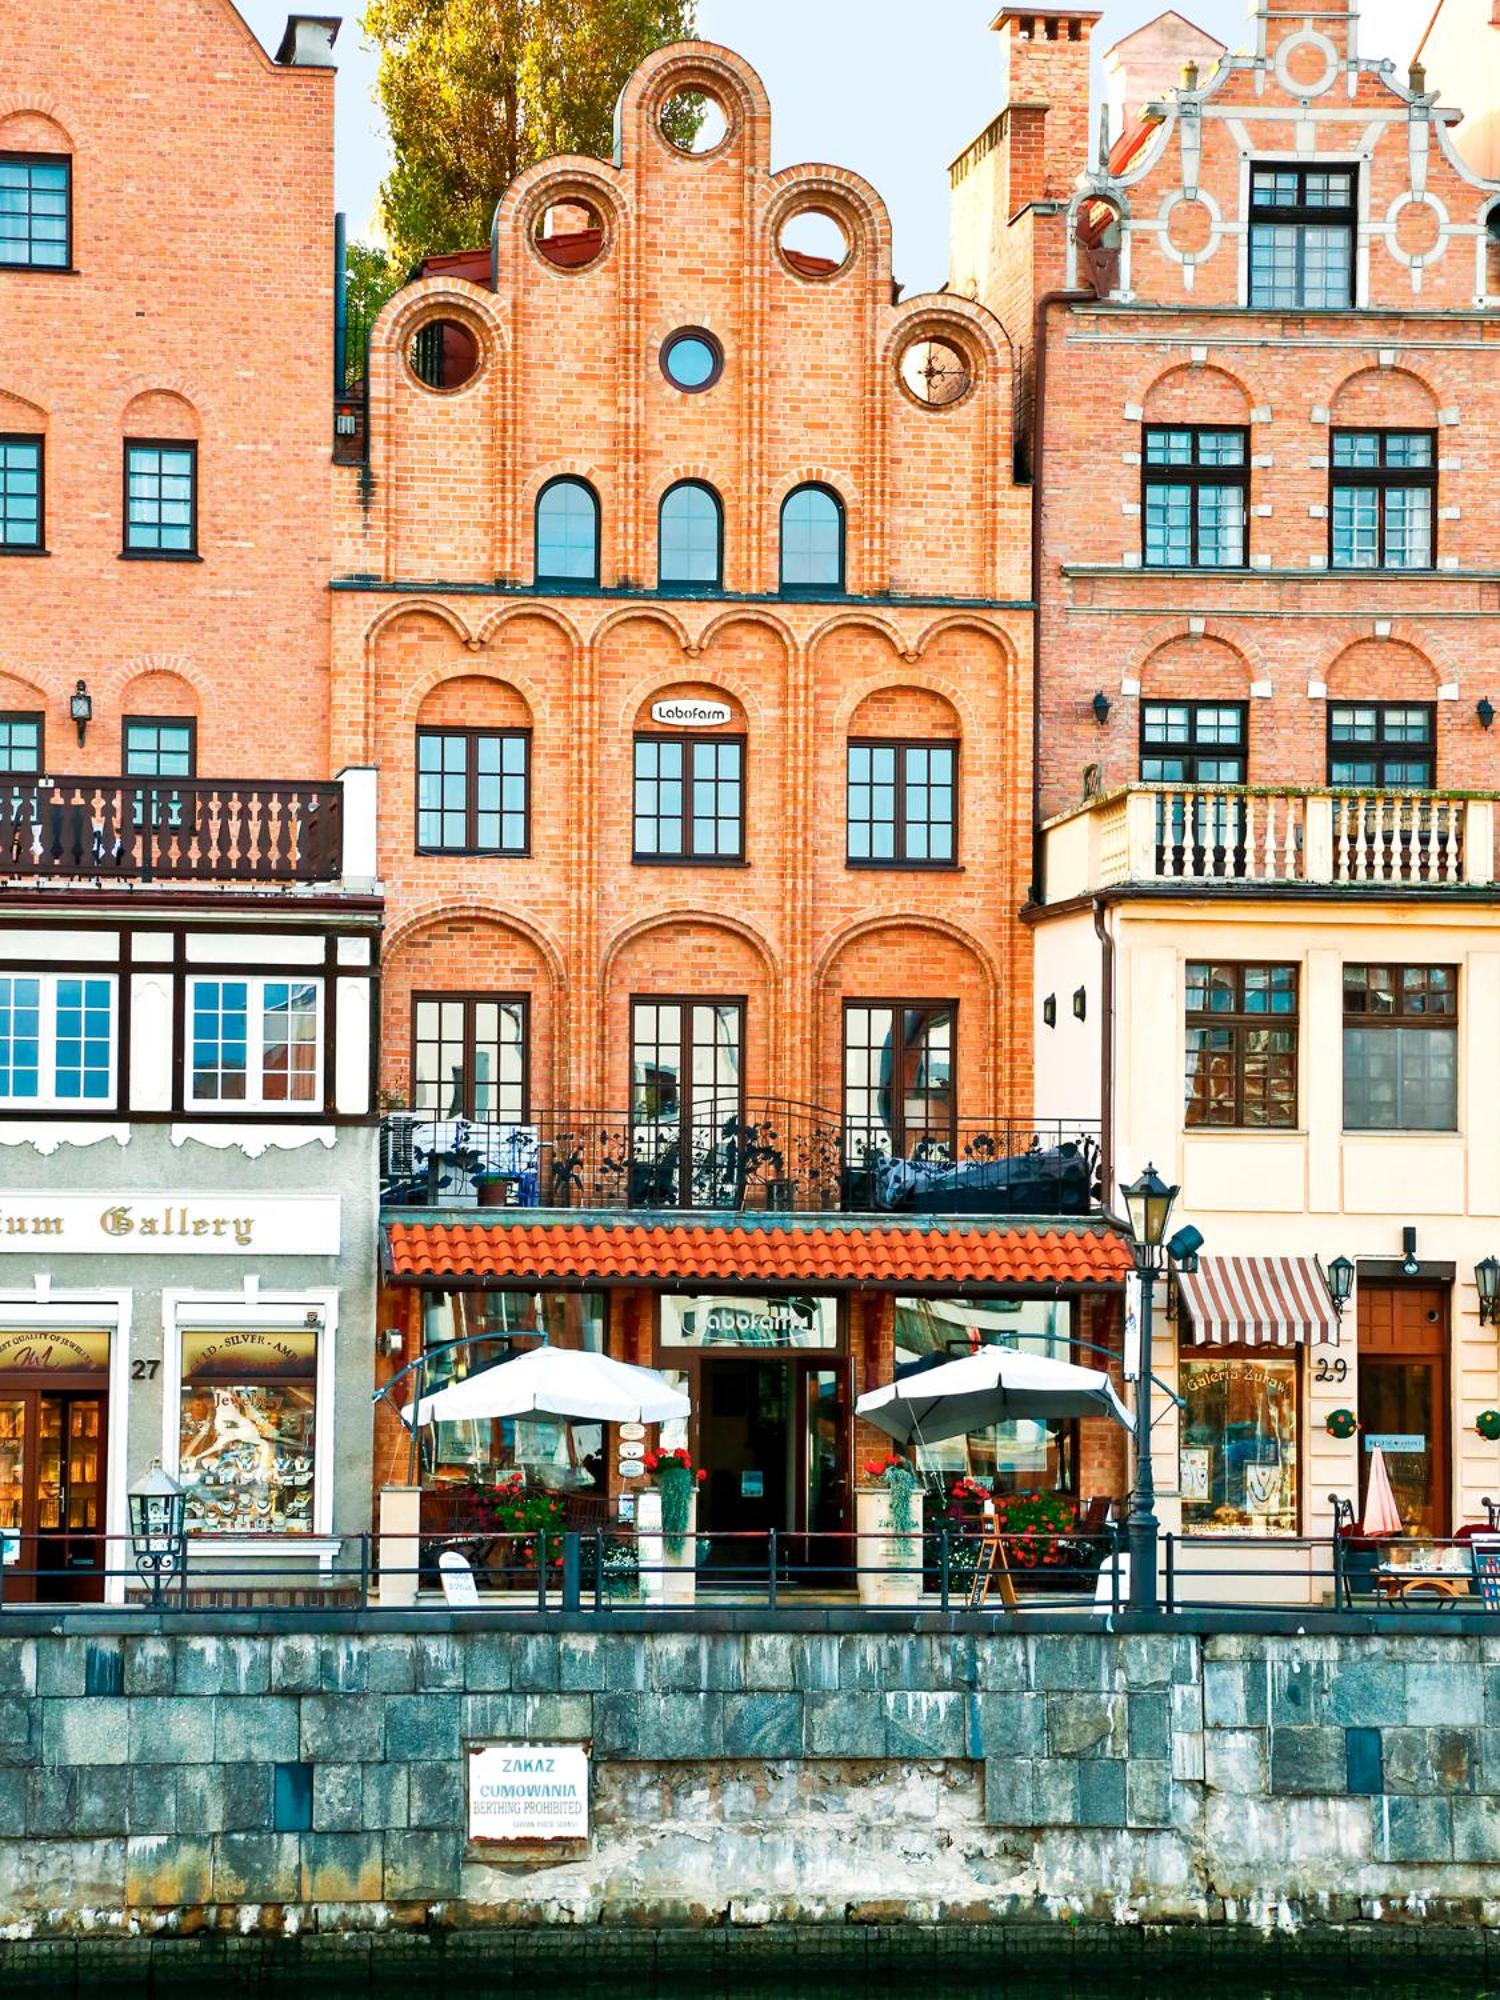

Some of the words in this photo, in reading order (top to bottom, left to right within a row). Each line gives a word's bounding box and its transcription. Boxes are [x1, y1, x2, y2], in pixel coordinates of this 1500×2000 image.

[658, 706, 725, 720] Labofarm
[0, 1210, 64, 1235] um
[100, 1206, 254, 1246] Gallery
[12, 1333, 48, 1345] QUALITY
[49, 1334, 61, 1343] OF
[224, 1334, 265, 1347] SILVER
[131, 1359, 161, 1380] 27
[1315, 1358, 1347, 1383] 29
[502, 1759, 556, 1773] ZAKAZ
[480, 1784, 577, 1798] CUMOWANIA
[473, 1801, 521, 1815] BERTHING
[523, 1801, 582, 1815] PROHIBITED
